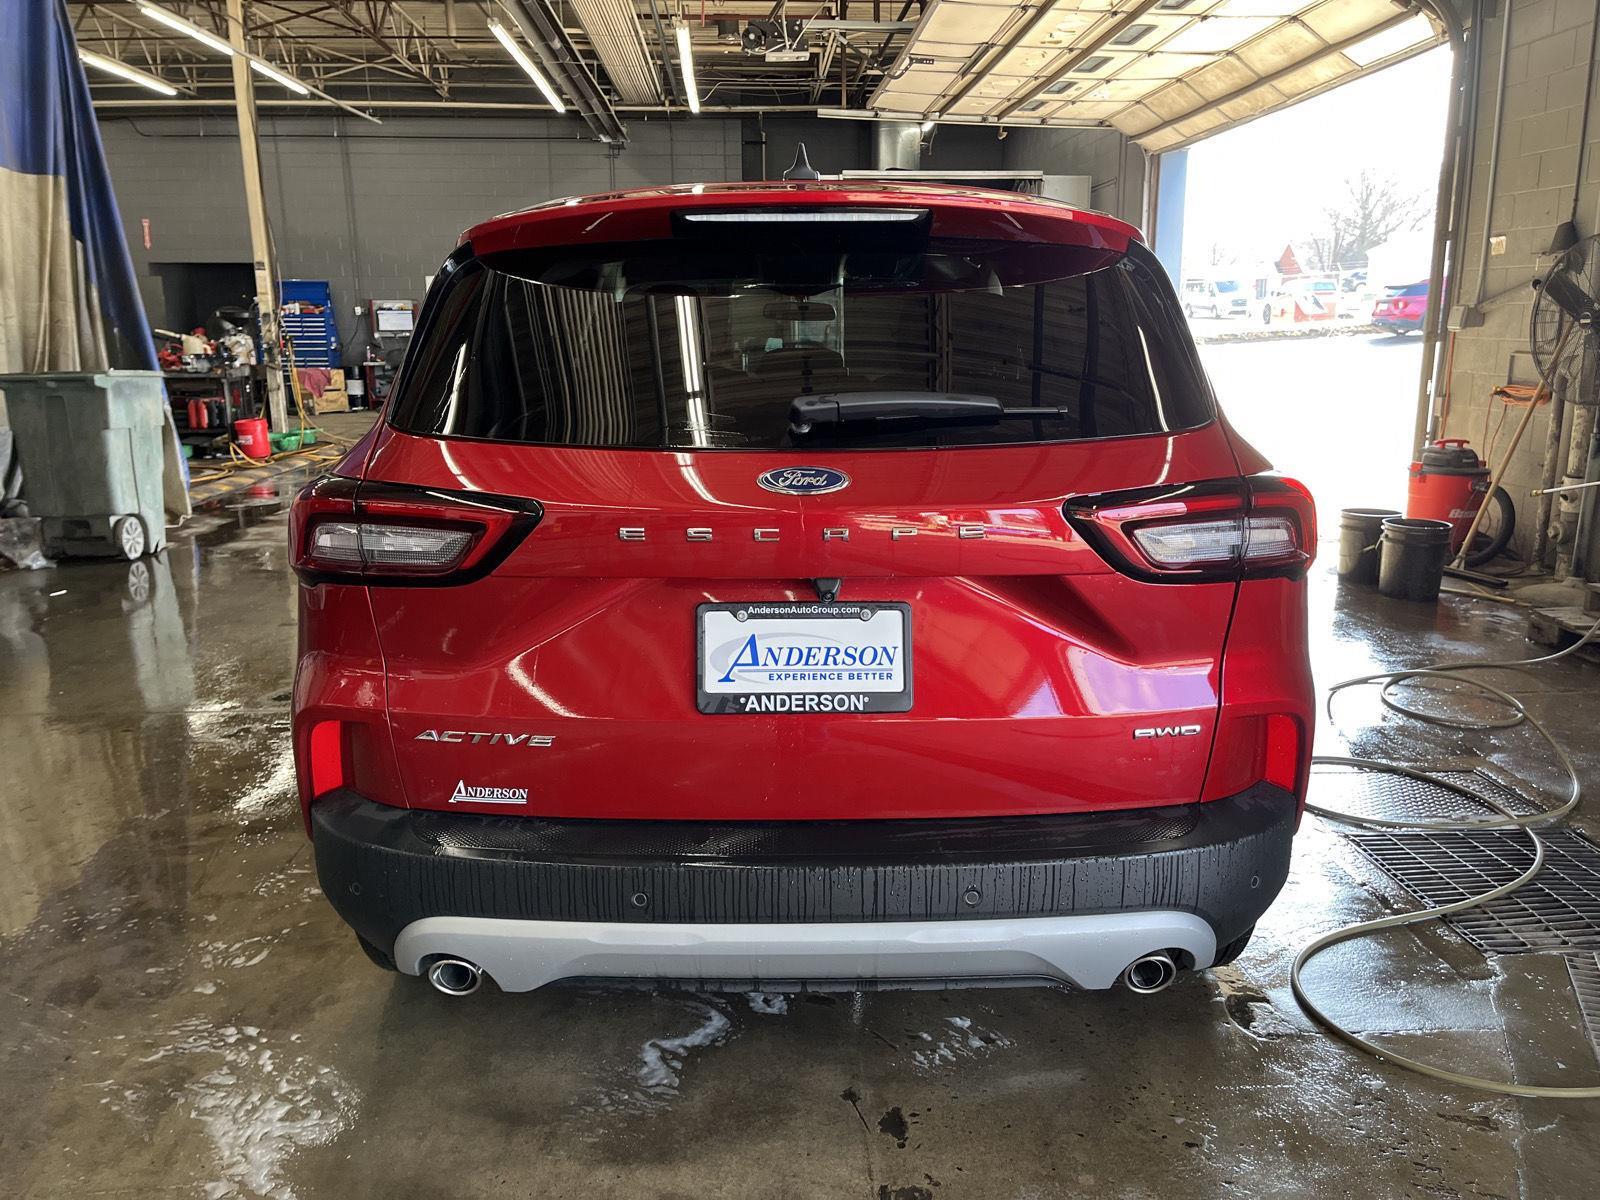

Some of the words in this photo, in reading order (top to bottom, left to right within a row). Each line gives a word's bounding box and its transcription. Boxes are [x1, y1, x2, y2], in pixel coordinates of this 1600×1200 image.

[778, 470, 829, 486] Ford
[619, 524, 985, 542] ESCAPE
[747, 605, 860, 616] AndersonAutoGroup.com
[717, 633, 898, 683] ANDERSON
[768, 672, 843, 681] EXPERIENCE
[848, 672, 893, 681] BETTER
[414, 729, 556, 747] ACTIVE
[1133, 725, 1201, 739] AWD
[448, 779, 528, 803] ANDERSON
